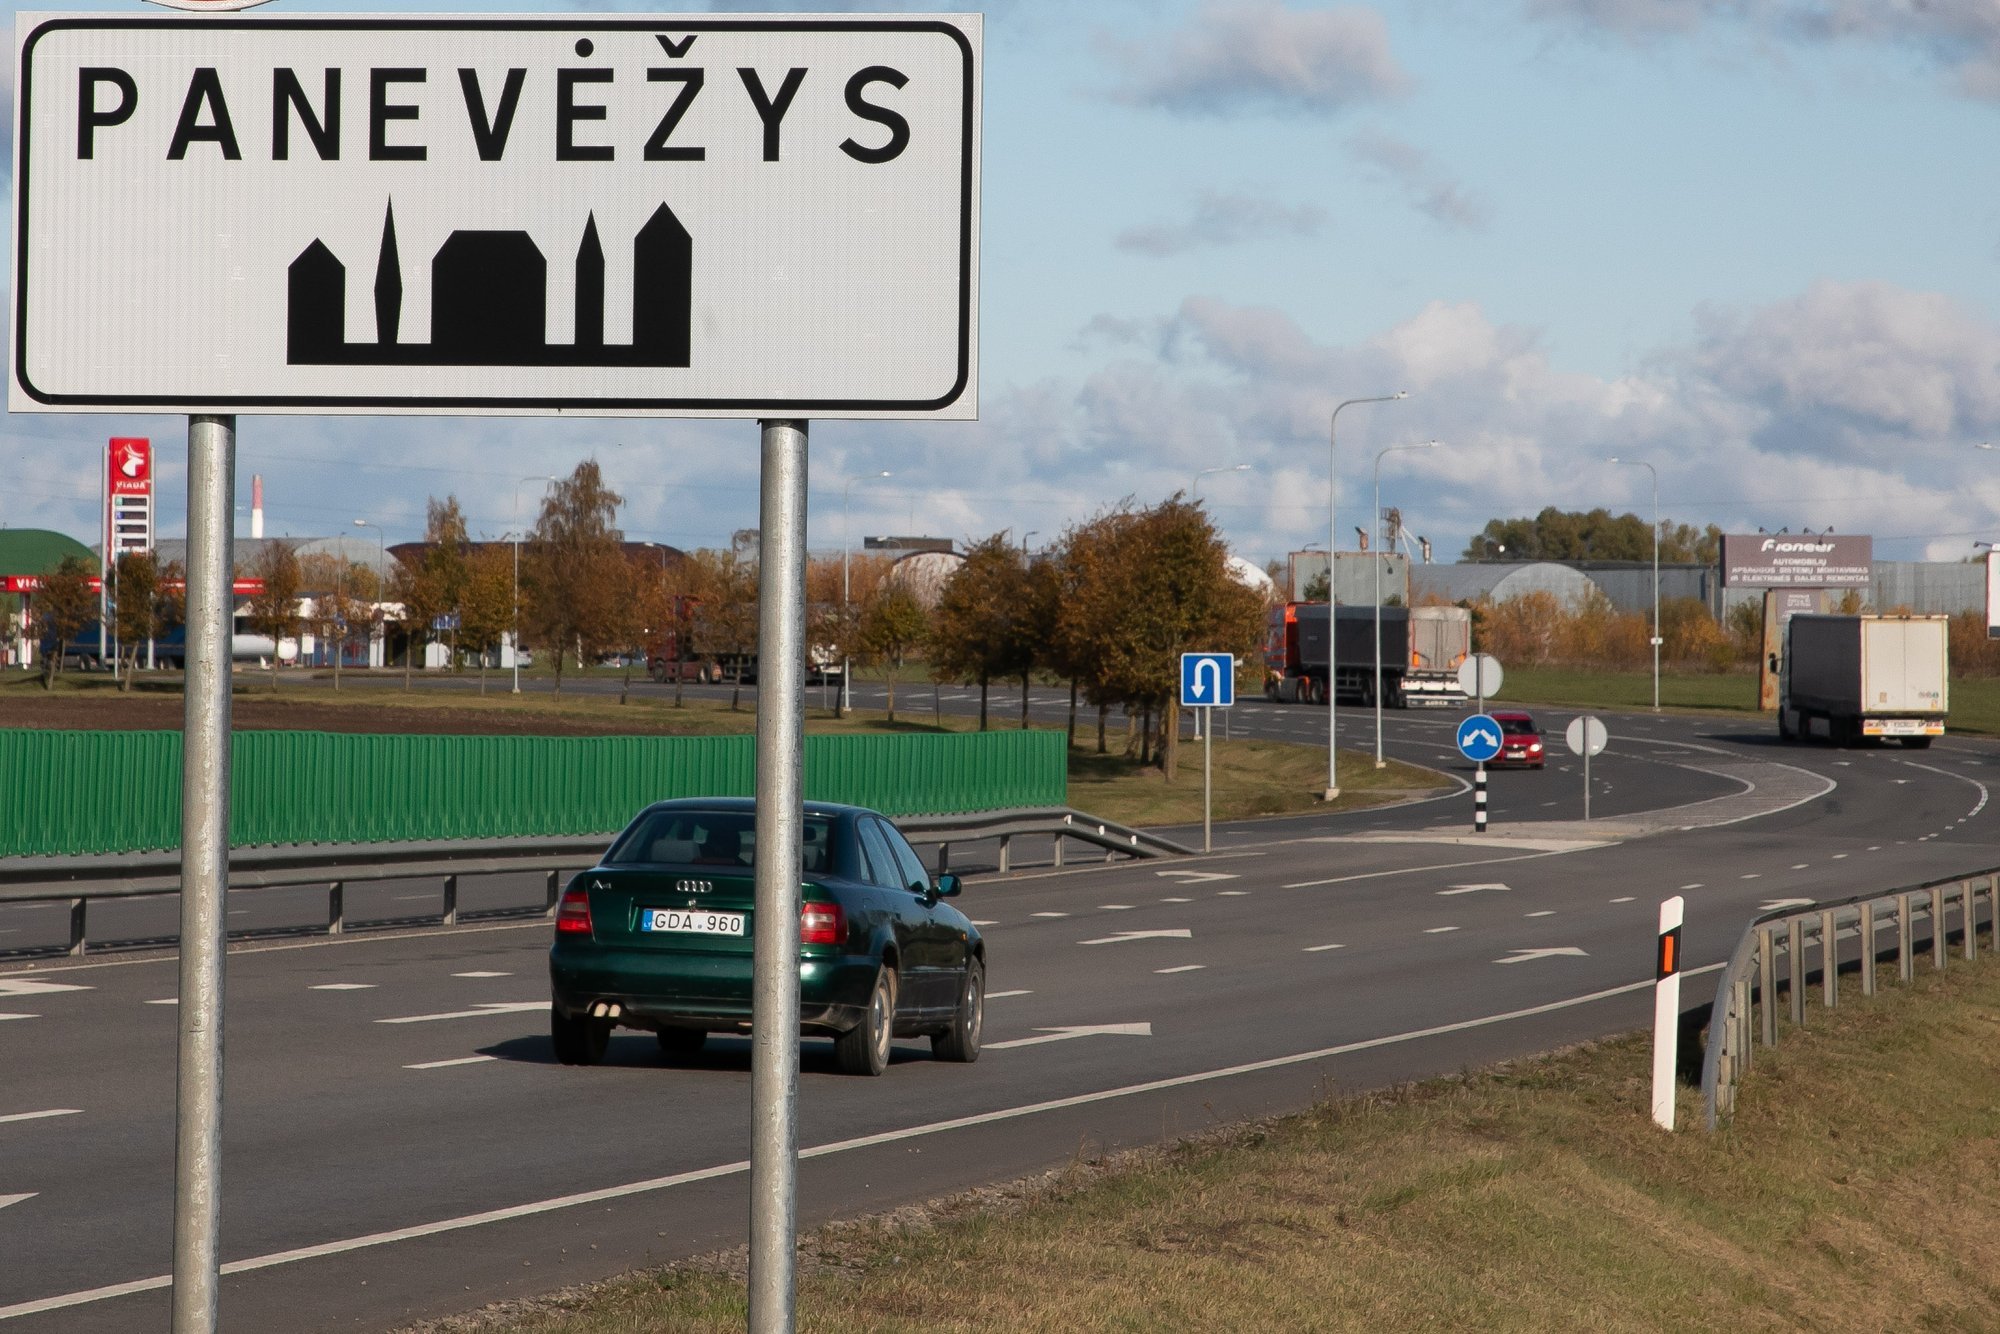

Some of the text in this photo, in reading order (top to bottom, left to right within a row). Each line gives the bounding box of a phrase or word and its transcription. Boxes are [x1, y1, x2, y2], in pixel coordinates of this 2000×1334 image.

[76, 34, 911, 164] PANEVĖŽYS
[655, 913, 741, 932] GDA 960
